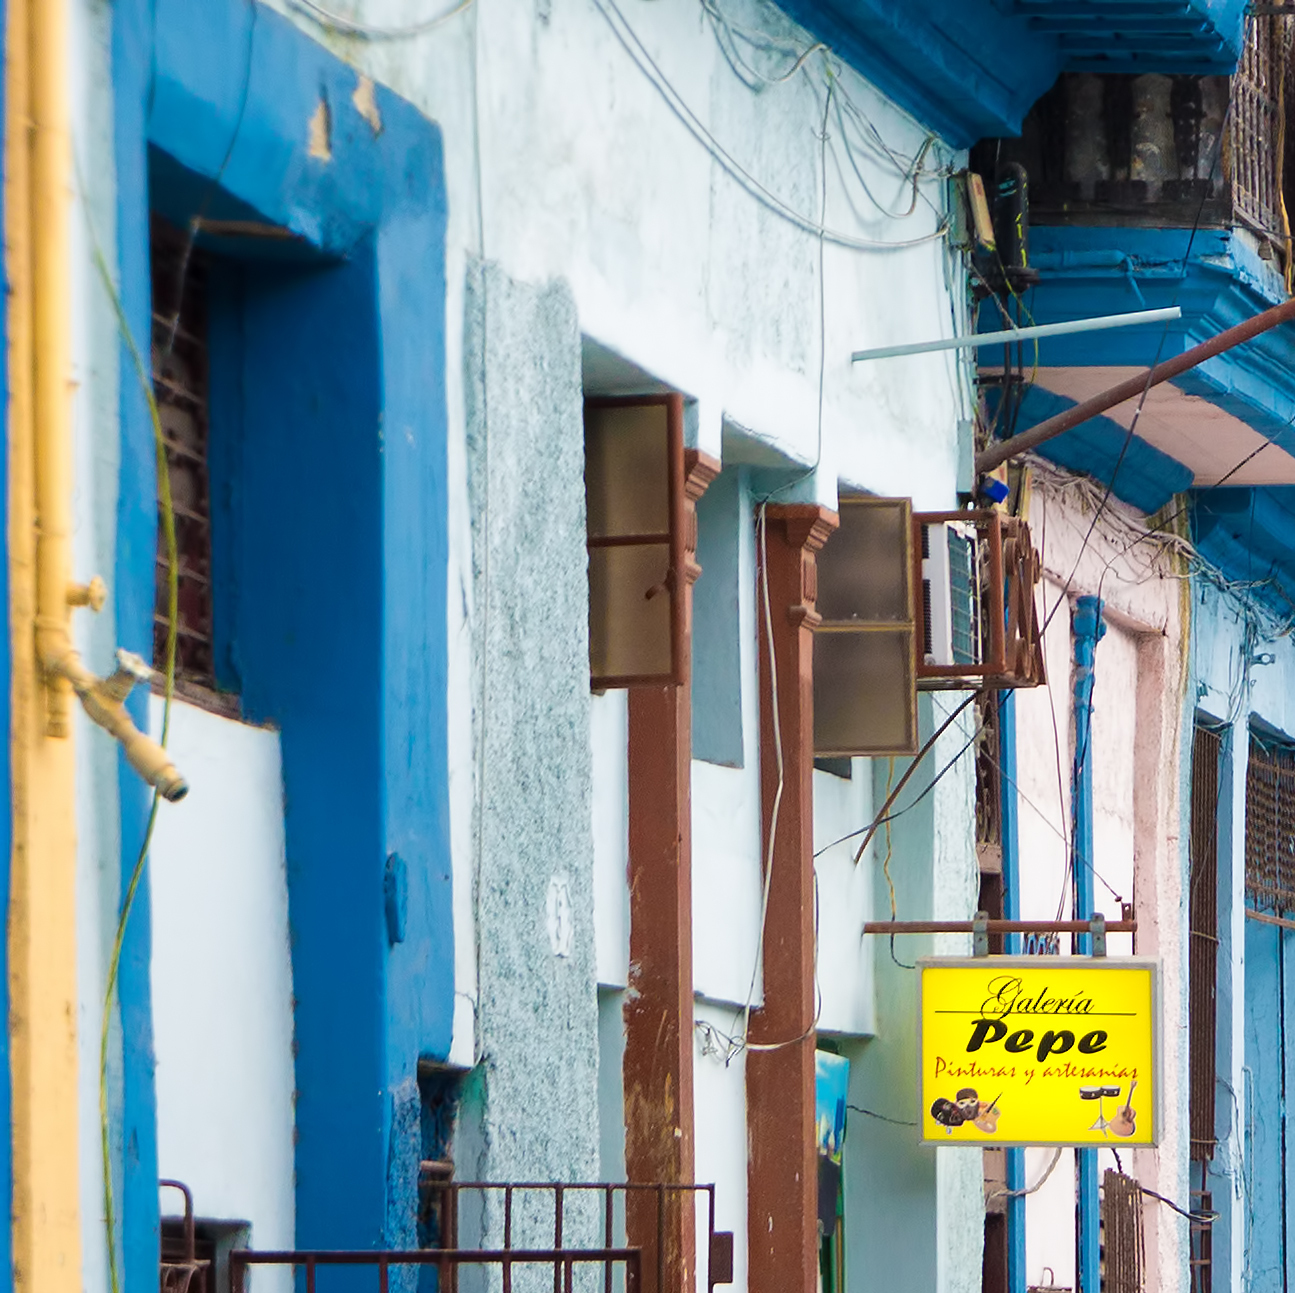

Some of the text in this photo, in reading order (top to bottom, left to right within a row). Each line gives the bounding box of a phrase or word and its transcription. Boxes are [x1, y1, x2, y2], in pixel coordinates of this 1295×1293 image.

[981, 975, 1094, 1020] Galería
[966, 1019, 1108, 1062] Pepe
[935, 1056, 1138, 1085] Pinturas y artesanías
